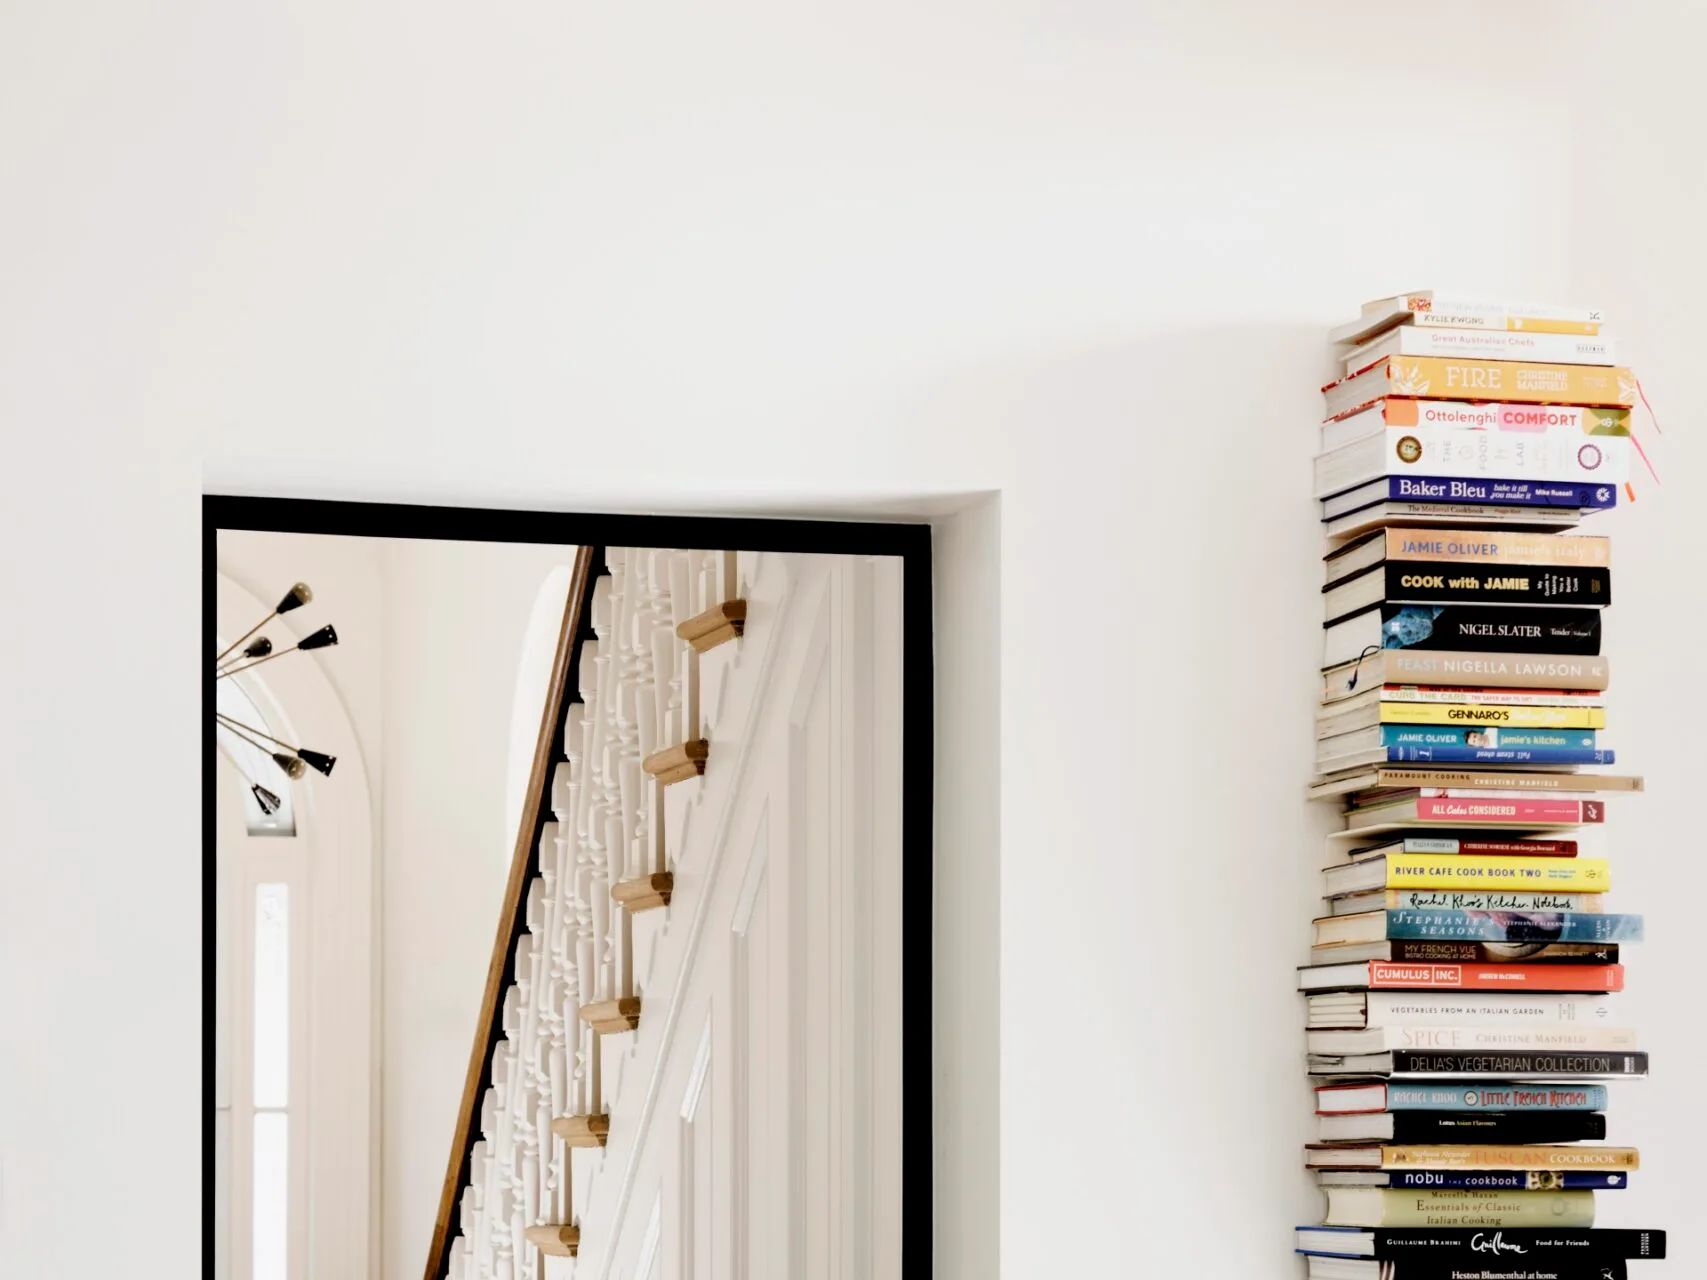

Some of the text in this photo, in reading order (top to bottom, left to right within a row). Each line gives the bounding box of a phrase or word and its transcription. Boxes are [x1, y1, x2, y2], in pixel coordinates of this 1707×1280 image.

[1424, 314, 1484, 326] KYLIE KWONG
[1432, 334, 1535, 347] Great Australian Chefs
[1445, 365, 1501, 388] FIRE
[1426, 409, 1576, 425] Ottolenghi COMFORT
[1479, 435, 1488, 470] FOOD
[1399, 479, 1486, 498] Baker Bleu
[1493, 483, 1528, 492] bake it till
[1550, 489, 1573, 497] Russell
[1490, 491, 1505, 500] you
[1505, 491, 1525, 499] make
[1408, 504, 1420, 513] The
[1450, 505, 1484, 514] Cookbook
[1402, 541, 1498, 555] JAMIE OLIVER
[1400, 575, 1530, 590] COOK with JAMIE
[1537, 580, 1544, 590] My
[1459, 623, 1497, 636] NIGEL
[1498, 624, 1542, 637] SLATER
[1550, 628, 1571, 636] Tender
[1397, 658, 1582, 676] FEAST NIGELLA LAWSON
[1420, 691, 1437, 699] THE
[1448, 709, 1510, 721] GENNARO'S
[1397, 733, 1566, 746] JAMIE OLIVER jamie's kitchen
[1476, 751, 1514, 759] steam ahead
[1384, 772, 1470, 781] PARAMOUNT COOKING
[1432, 804, 1445, 815] ALL
[1446, 804, 1468, 816] Cakes
[1468, 805, 1515, 816] CONSIDERED
[1395, 867, 1425, 876] RIVER
[1429, 867, 1452, 876] CAFE
[1456, 868, 1484, 876] COOK
[1488, 868, 1516, 877] BOOK
[1519, 868, 1542, 878] TWO
[1452, 893, 1484, 909] Khoo's
[1393, 911, 1495, 926] STEPHANIE'S
[1539, 920, 1577, 928] ALEXANDER
[1420, 926, 1485, 935] SEASONS
[1404, 945, 1418, 953] MY
[1420, 945, 1457, 954] FRENCH
[1458, 945, 1477, 954] VUE
[1376, 969, 1458, 981] CUMULUS INC.
[1466, 1007, 1476, 1015] AN
[1479, 1007, 1509, 1015] ITALIAN
[1402, 1027, 1588, 1047] SPICE CHRISTINE MANFIELD
[1410, 1056, 1454, 1071] DELIA'S
[1458, 1056, 1531, 1072] VEGETARIAN
[1534, 1056, 1610, 1072] COLLECTION
[1480, 1090, 1509, 1107] LITTLE
[1512, 1090, 1547, 1107] FRENCH
[1548, 1090, 1587, 1108] KITCHEN
[1472, 1119, 1497, 1127] Flavours
[1474, 1151, 1547, 1164] TUSCAN
[1549, 1153, 1616, 1164] COOKBOOK
[1404, 1171, 1444, 1184] nobu
[1465, 1175, 1518, 1185] cookbook
[1431, 1191, 1469, 1199] Marcella
[1416, 1199, 1521, 1213] Essentials of Classic
[1427, 1215, 1502, 1226] Italian Cooking
[1386, 1238, 1427, 1246] GUILLAUME
[1451, 1270, 1558, 1280] Heston Blumenthal at home
